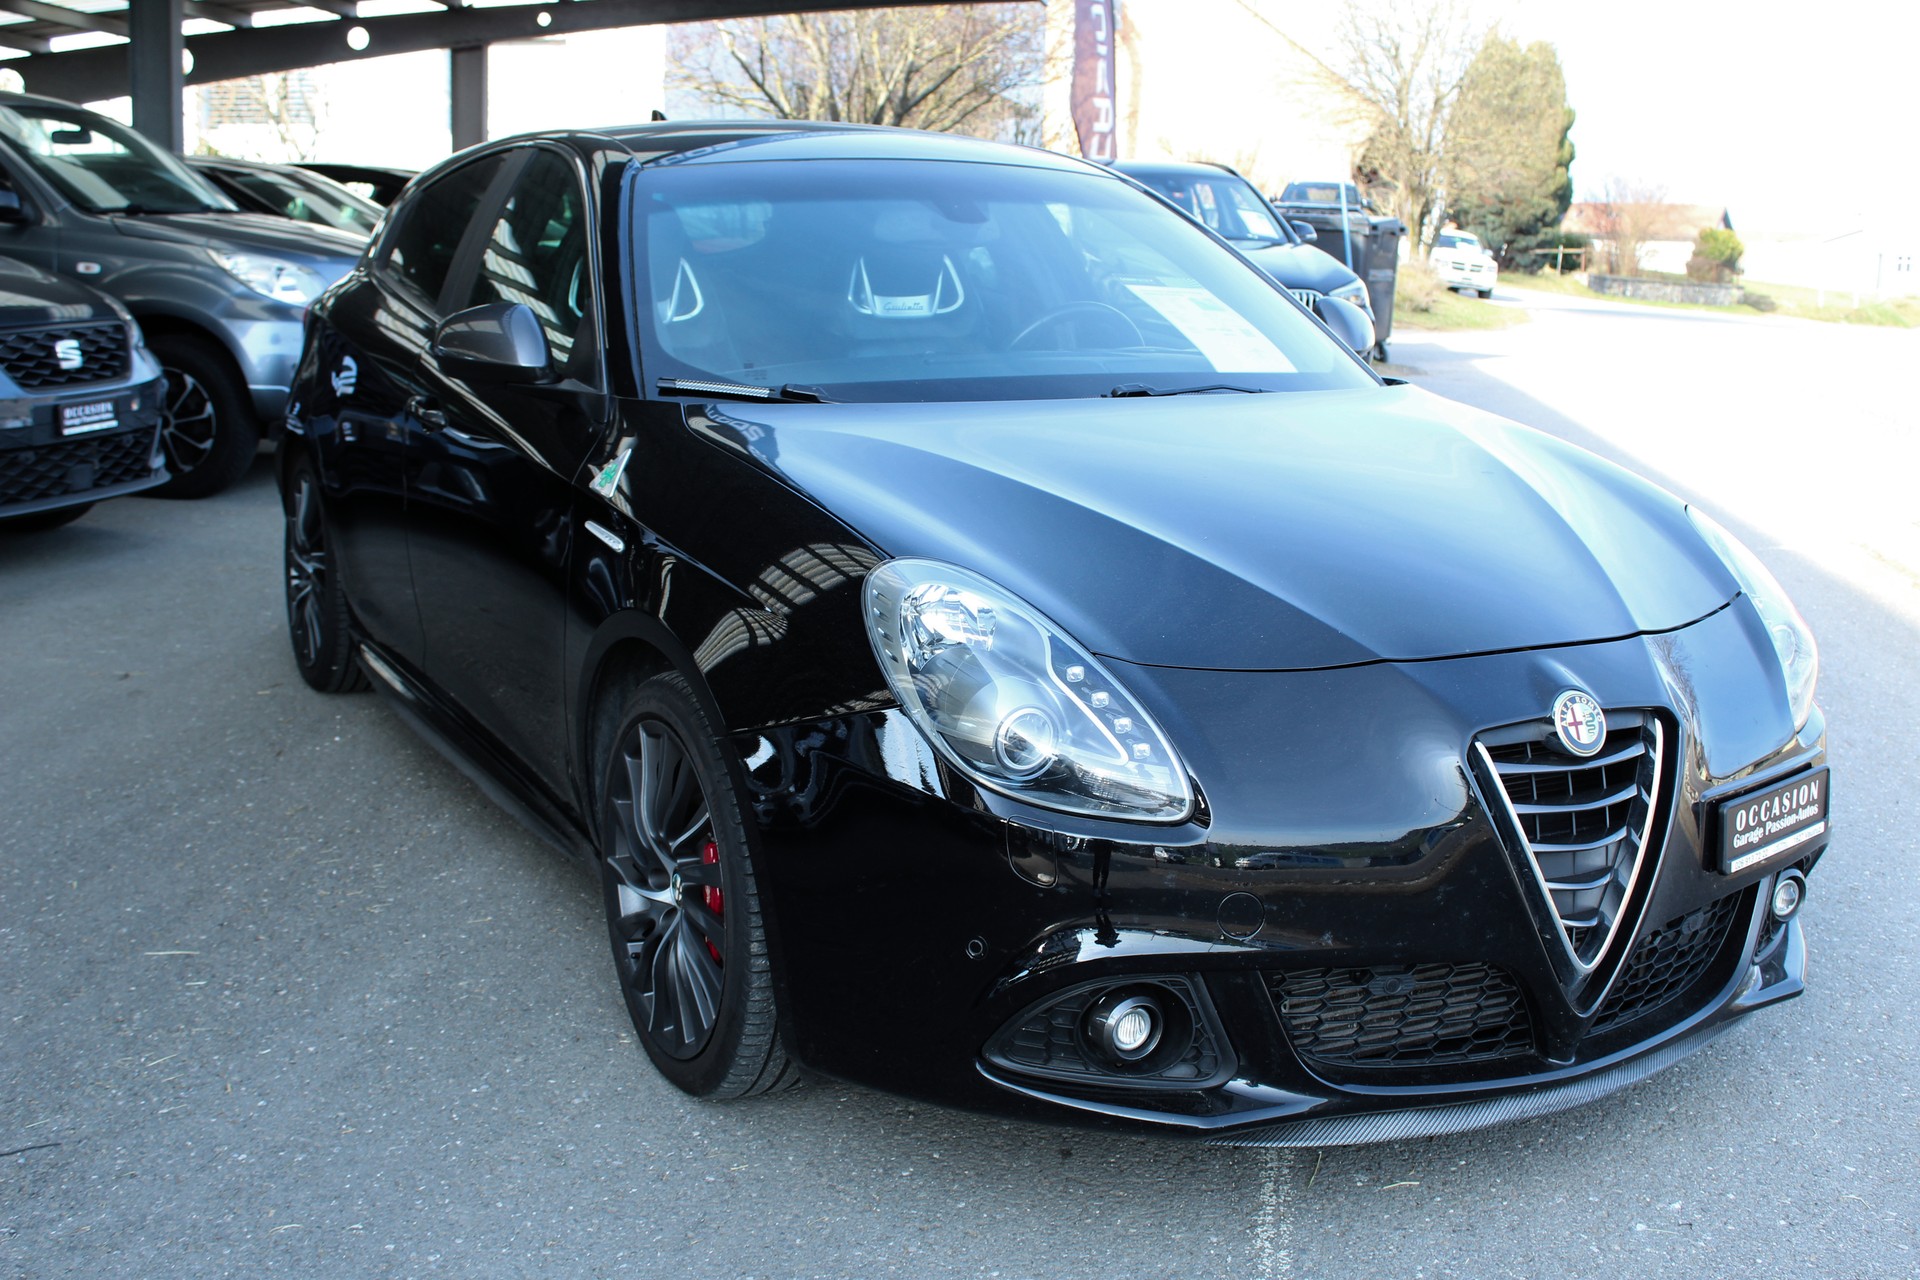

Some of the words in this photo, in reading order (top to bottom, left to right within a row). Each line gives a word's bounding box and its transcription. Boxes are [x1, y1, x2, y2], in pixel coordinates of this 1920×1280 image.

[1561, 699, 1573, 727] ALFA
[1574, 696, 1602, 722] ROMEO
[1733, 826, 1764, 849] Garage
[1765, 803, 1819, 836] Passion-Autos
[1735, 779, 1819, 832] OCCASION
